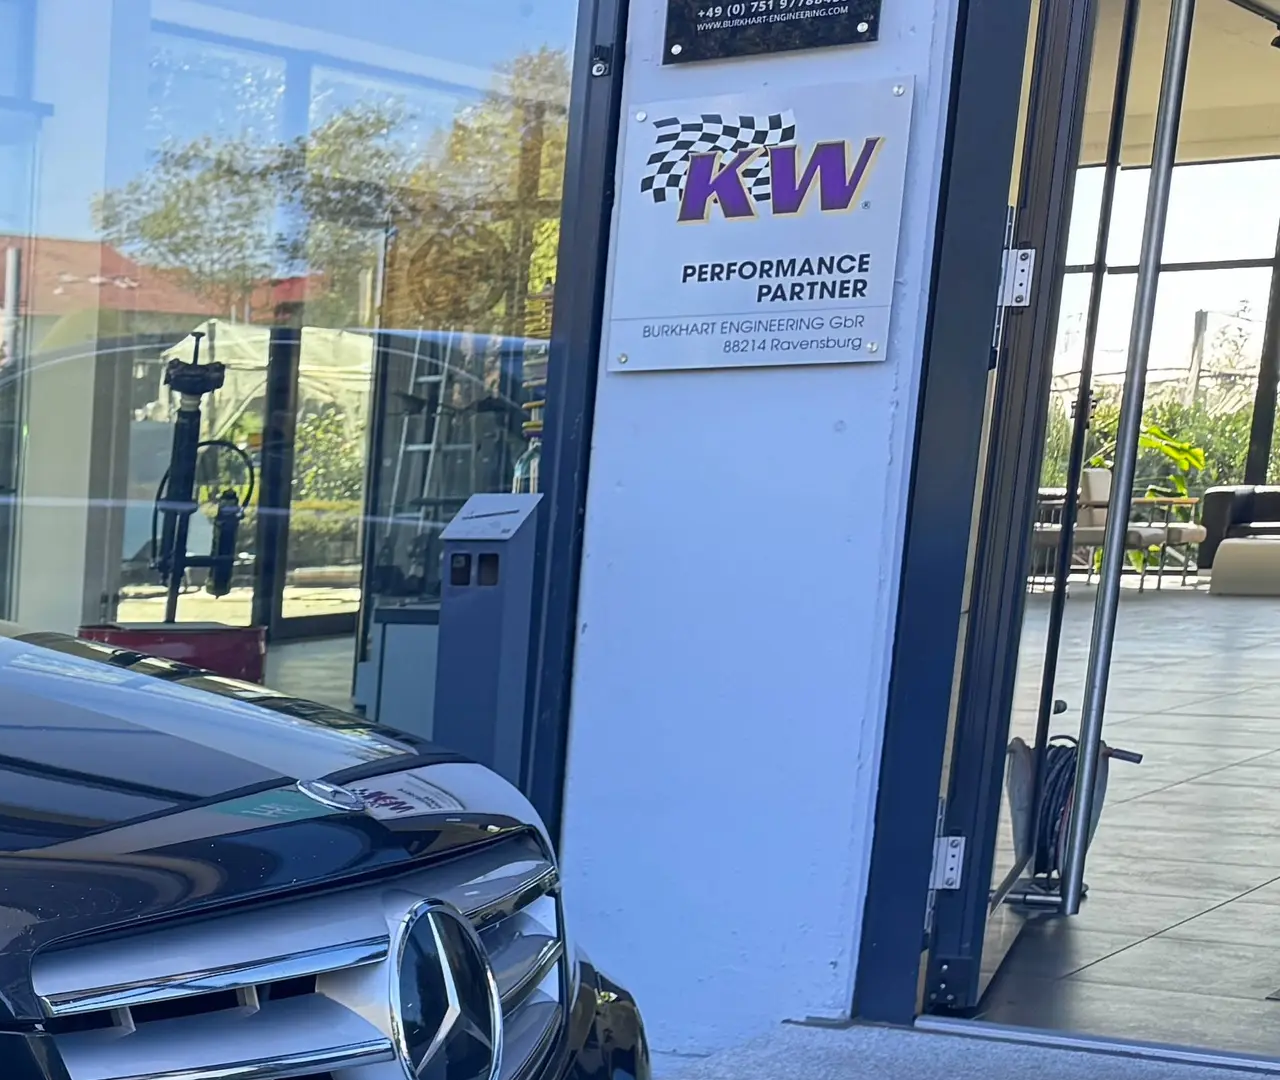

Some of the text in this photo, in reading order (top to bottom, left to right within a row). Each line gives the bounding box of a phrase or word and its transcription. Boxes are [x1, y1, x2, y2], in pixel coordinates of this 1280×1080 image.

[696, 5, 849, 31] WWW.BURKHART-ENGINEERING.COM
[697, 5, 723, 18] +49
[727, 3, 746, 17] (0)
[750, 0, 774, 13] 751
[677, 136, 886, 225] KW
[681, 253, 871, 283] PERFORMANCE
[756, 279, 868, 303] PARTNER
[642, 315, 865, 338] BURKHART ENGINEERING GbR
[722, 335, 862, 354] 88214 Ravensburg
